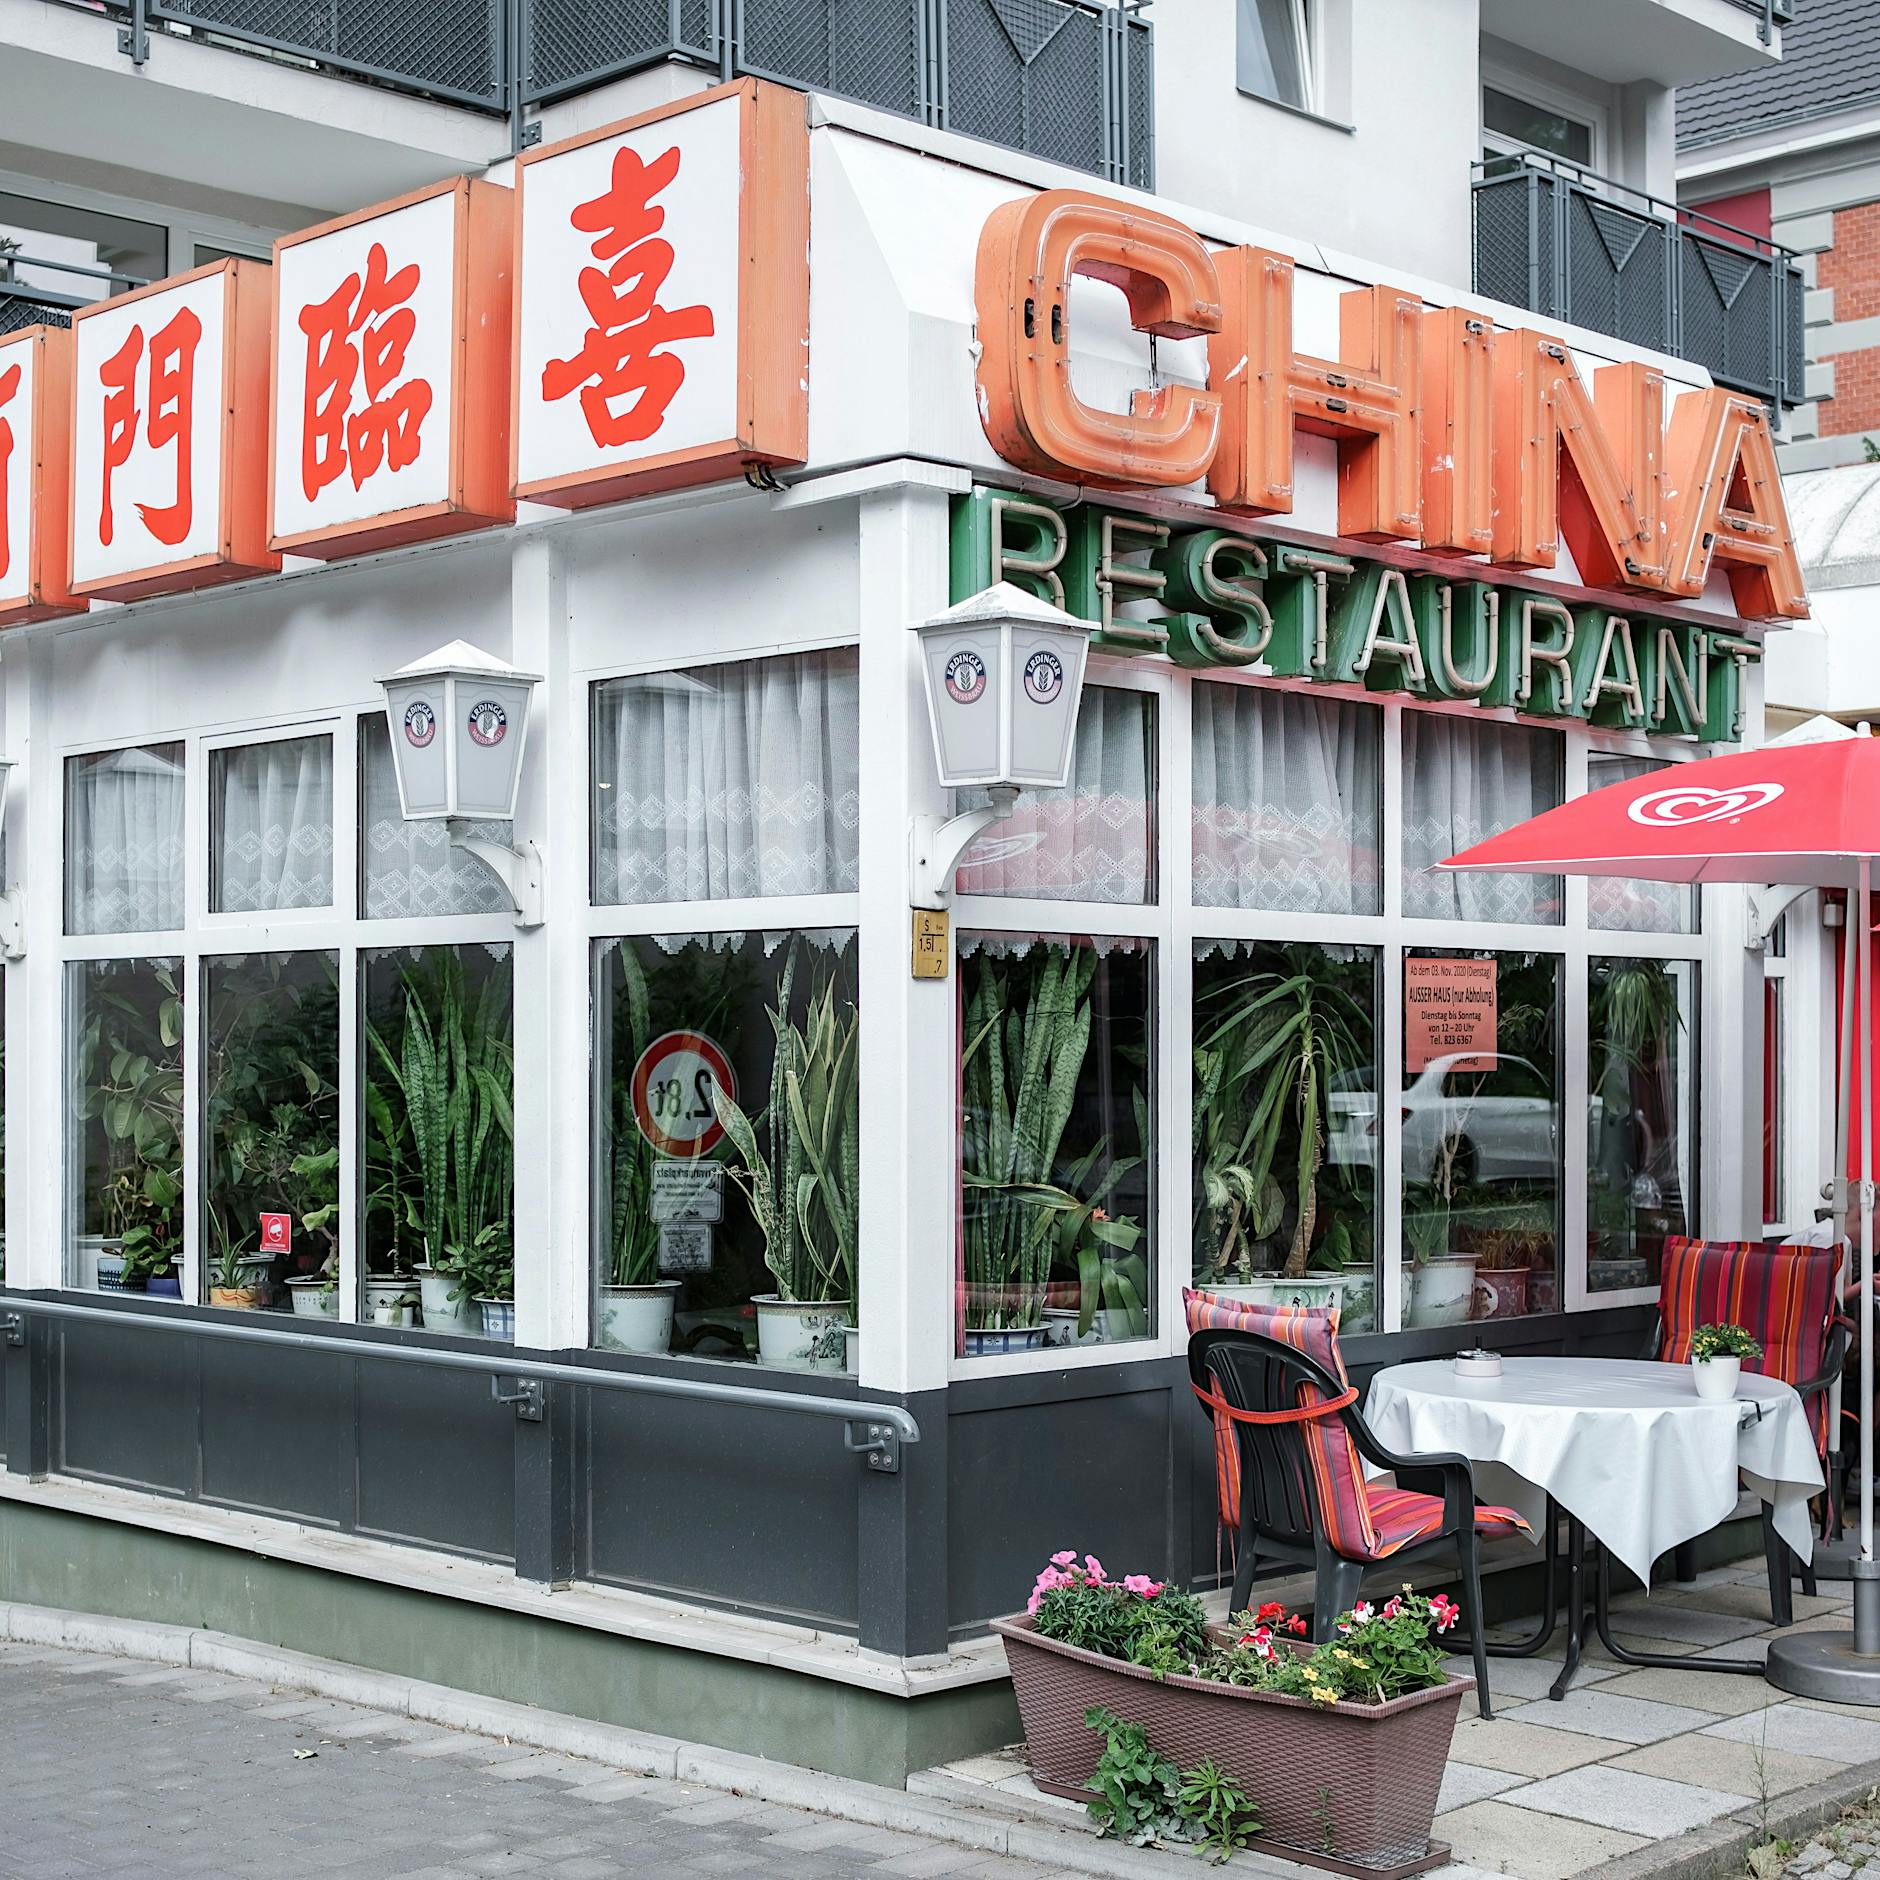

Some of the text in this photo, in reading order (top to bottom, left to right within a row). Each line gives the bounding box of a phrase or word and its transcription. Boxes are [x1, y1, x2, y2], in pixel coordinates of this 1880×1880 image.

[973, 188, 1811, 623] CHINA
[950, 488, 1766, 742] RESTAURANT
[946, 653, 983, 677] ERDINGER
[1026, 653, 1060, 677] ERDINGER
[405, 704, 433, 723] ERDINGER
[471, 703, 505, 722] ERDINGER
[1410, 965, 1417, 976] Ab
[1419, 965, 1430, 976] dem
[1441, 966, 1453, 976] Nov.
[1453, 966, 1467, 977] 2020
[1467, 966, 1492, 980] (Dienstag)
[1409, 985, 1494, 1007] AUSSER HAUS (nur Abholung)
[1421, 1010, 1482, 1021] Dienstag bis Sonntag
[1428, 1024, 1439, 1032] von
[1441, 1023, 1449, 1032] 12
[1455, 1024, 1462, 1032] 20
[1463, 1024, 1475, 1032] Uhr
[1430, 1035, 1473, 1045] Tel. 823 6367
